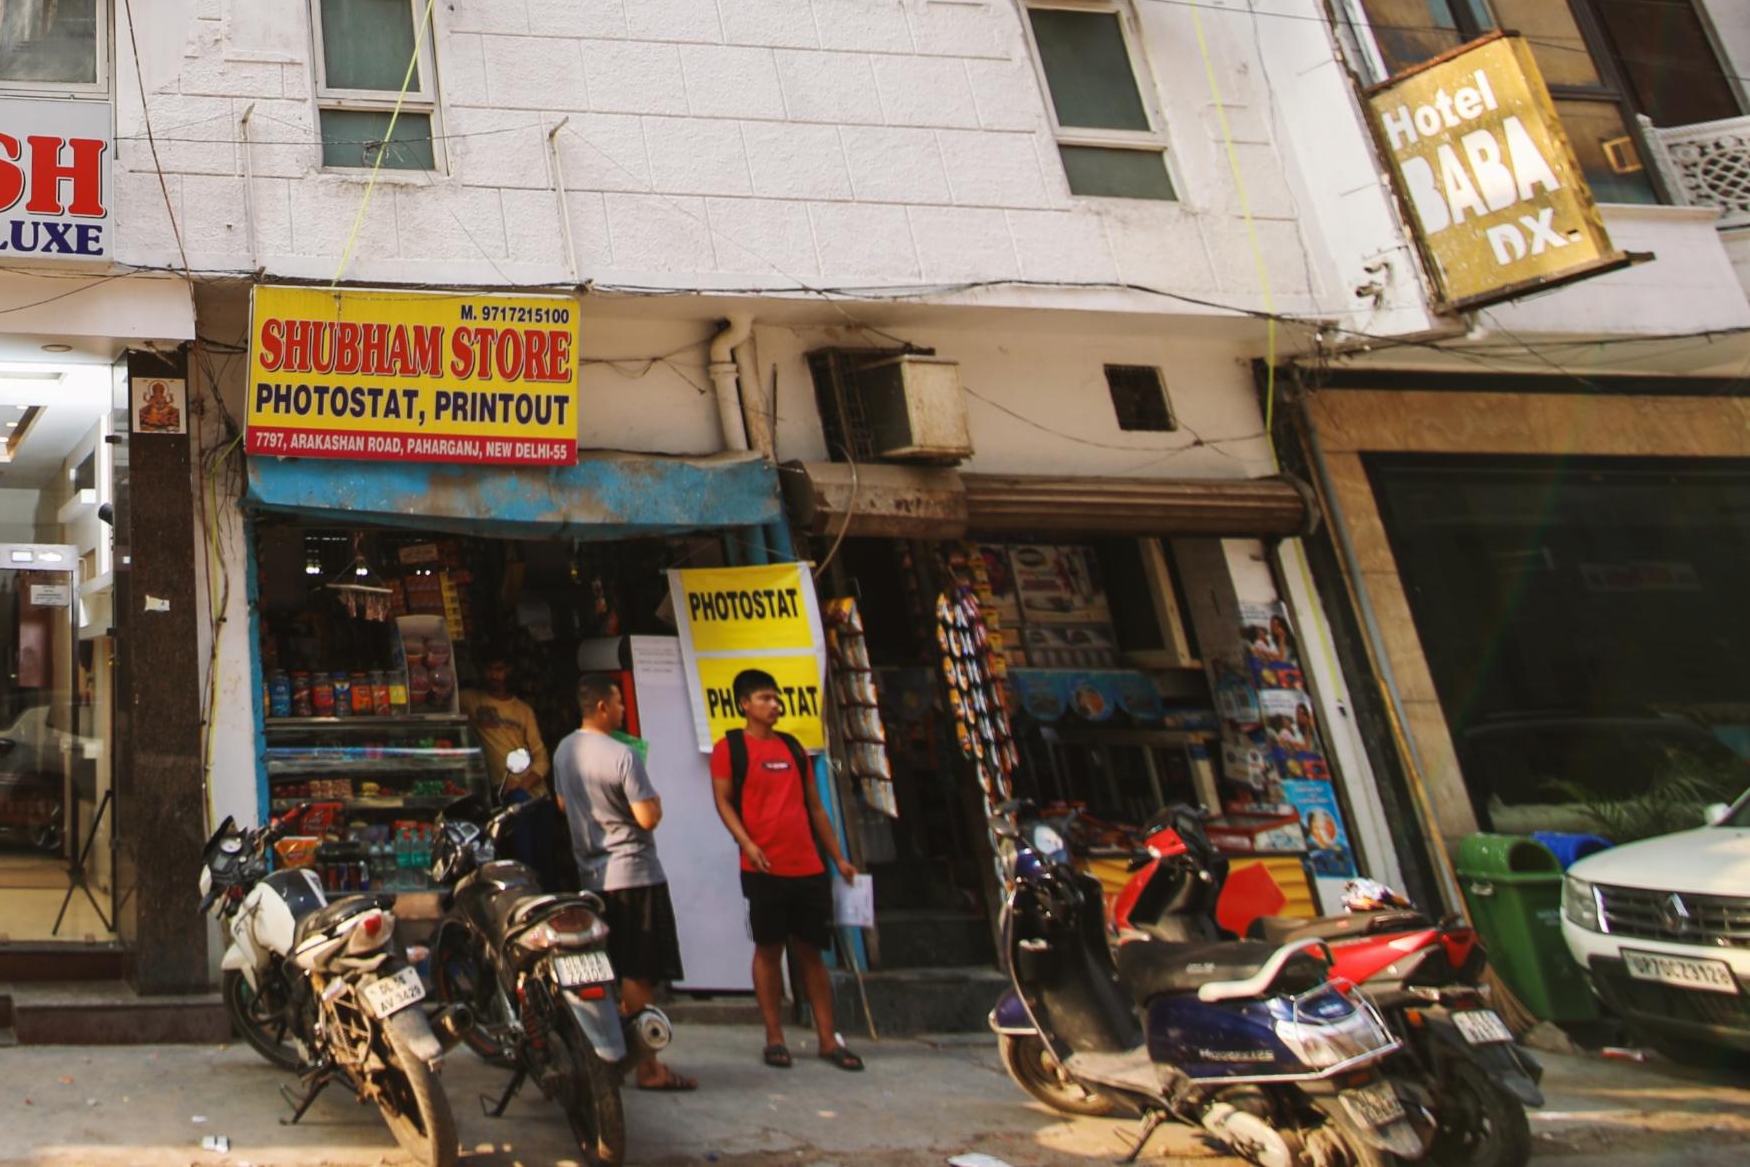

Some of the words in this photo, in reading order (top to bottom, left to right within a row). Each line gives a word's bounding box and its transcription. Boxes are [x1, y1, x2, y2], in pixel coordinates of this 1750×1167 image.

[1382, 68, 1498, 151] Hotel
[1400, 115, 1561, 235] BABA
[460, 305, 478, 321] M.
[482, 305, 569, 323] 9717215100
[259, 318, 444, 378] SHUBHAM
[450, 326, 572, 383] STORE
[256, 383, 426, 426] PHOTOSTAT,
[435, 390, 569, 426] PRINTOUT
[256, 431, 287, 451] 7797,
[290, 434, 366, 452] ARAKASHAN
[367, 436, 404, 455] ROAD,
[407, 438, 483, 459] PAHARGANJ,
[486, 441, 514, 459] NEW
[515, 441, 568, 460] DELHI-55
[688, 589, 800, 622] PHOTOSTAT
